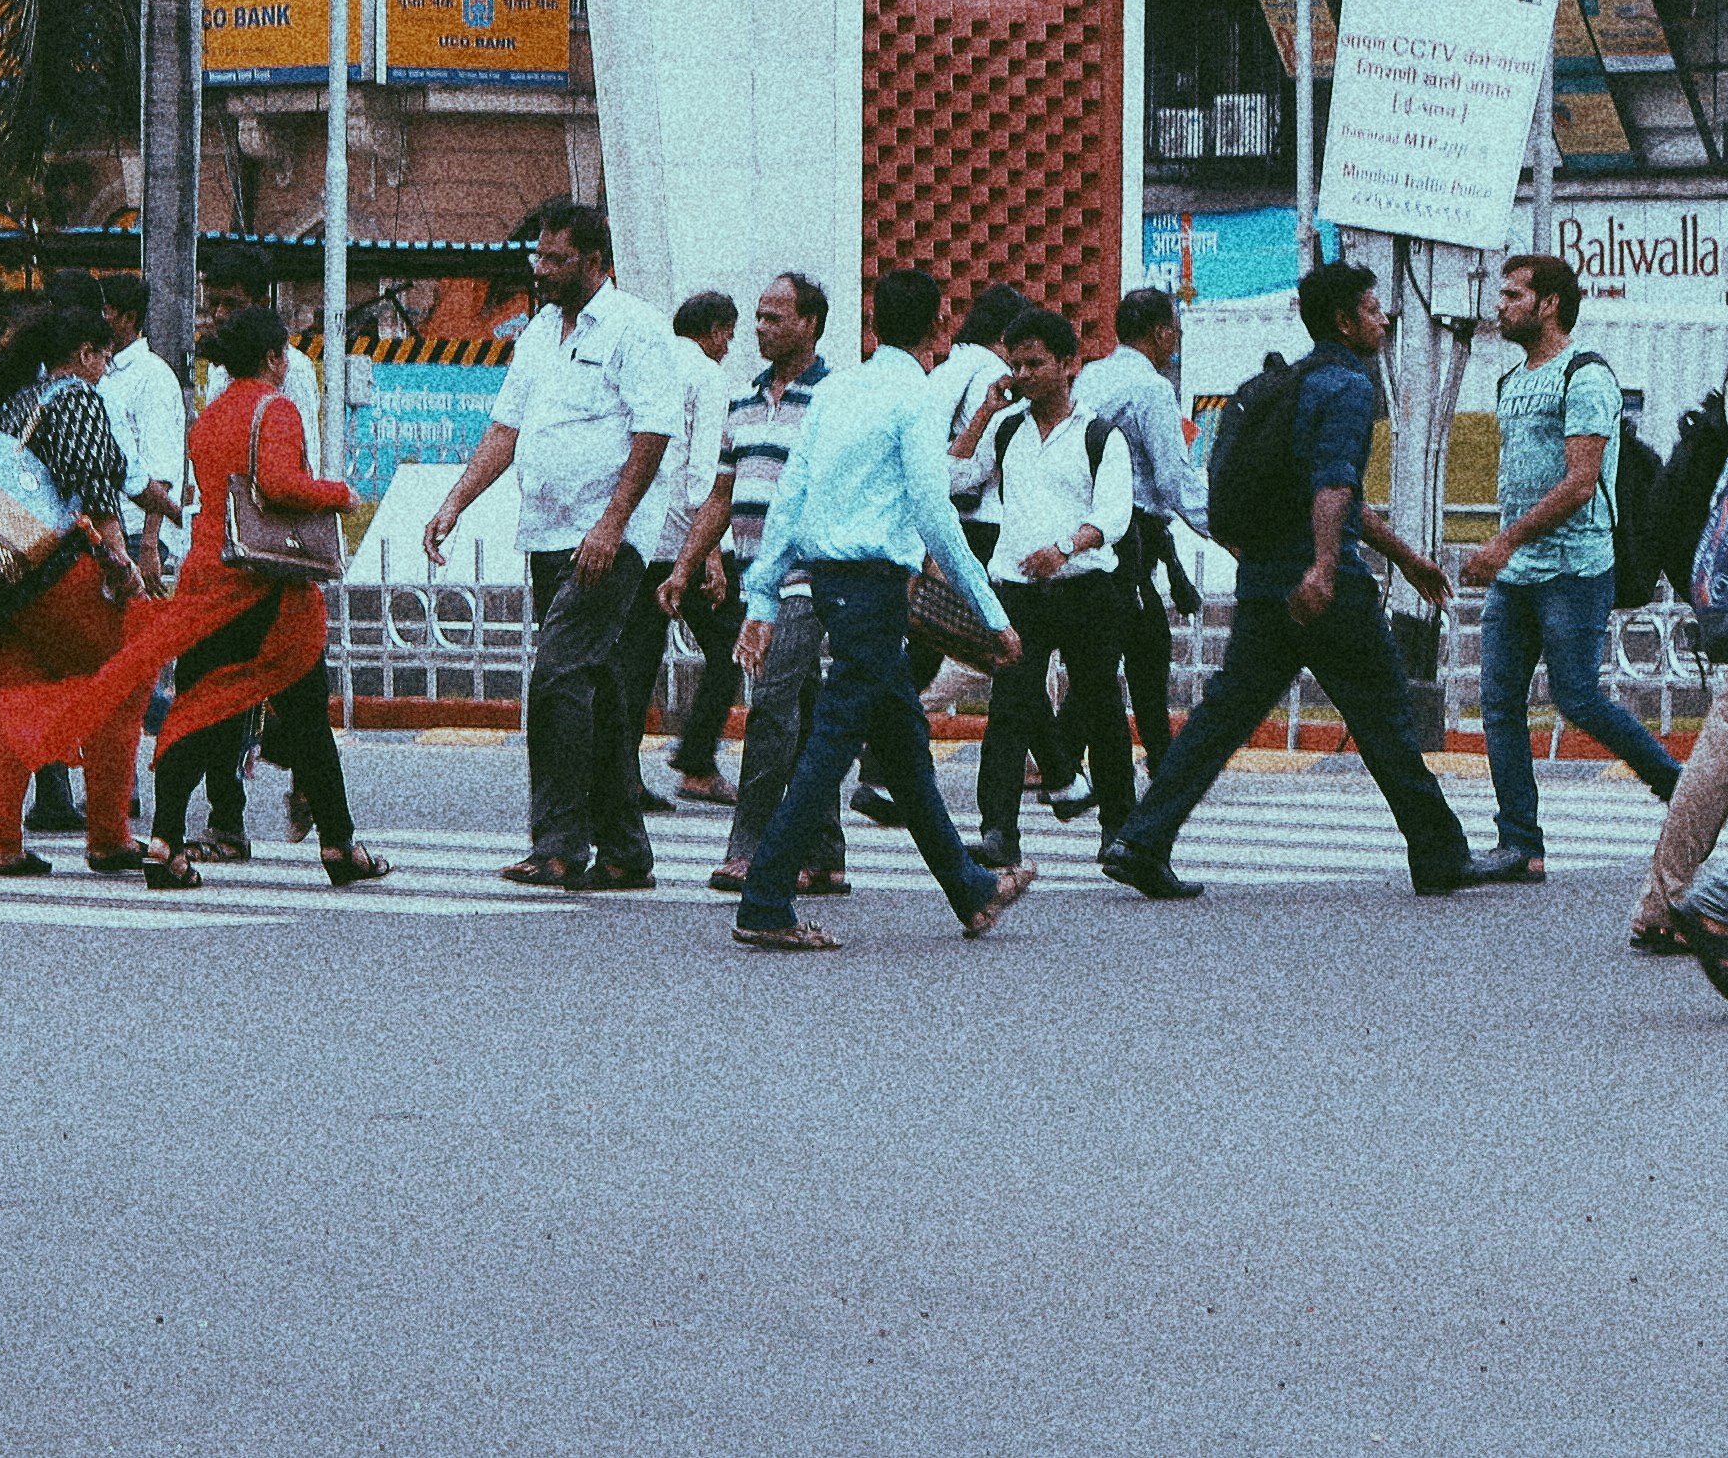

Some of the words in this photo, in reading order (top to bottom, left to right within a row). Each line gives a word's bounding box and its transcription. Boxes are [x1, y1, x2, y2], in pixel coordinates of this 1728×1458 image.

[234, 3, 291, 28] BANK
[439, 36, 470, 48] UCO
[475, 37, 517, 50] BANK
[1393, 36, 1458, 63] CCTV
[1451, 179, 1493, 199] Police
[1559, 213, 1719, 277] Baliwalla
